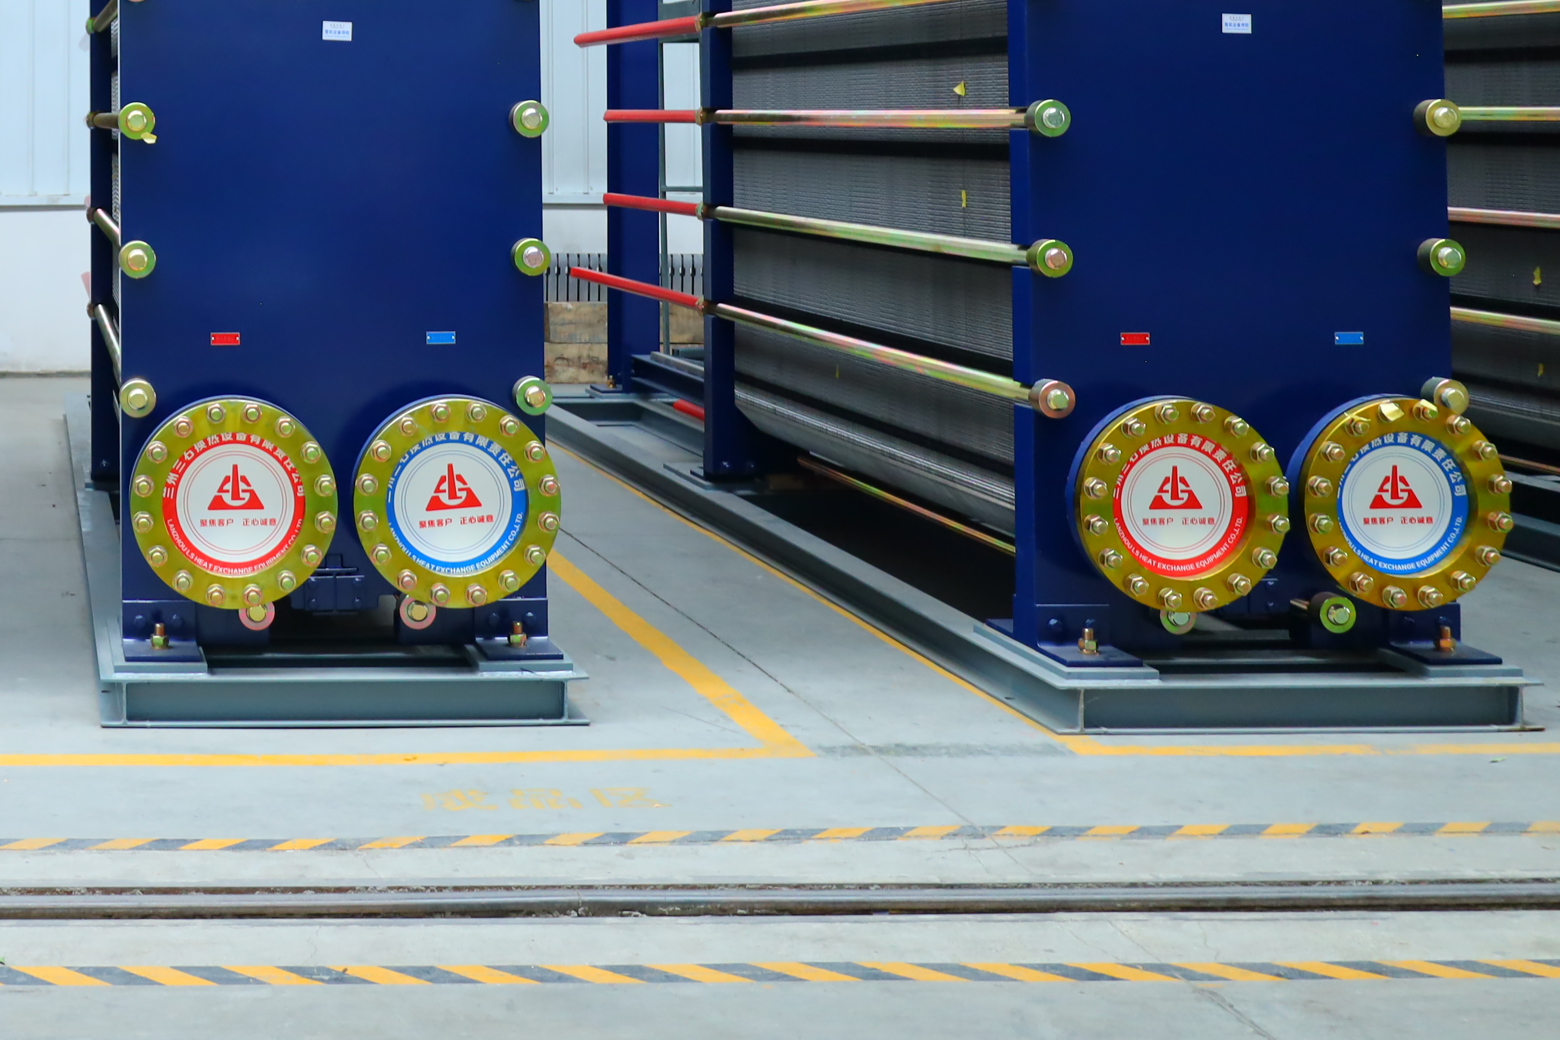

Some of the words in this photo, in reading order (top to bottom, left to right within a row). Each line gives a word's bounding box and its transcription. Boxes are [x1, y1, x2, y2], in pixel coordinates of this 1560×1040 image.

[200, 519, 233, 527] 聚焦客户
[243, 518, 277, 526] 正心诚意
[419, 520, 452, 528] 聚焦客户
[460, 515, 494, 525] 正心诚意
[1143, 518, 1173, 526] 聚焦客户
[1401, 517, 1434, 525] 正心诚意
[166, 518, 188, 552] LANZHOU
[193, 555, 213, 570] HEAT
[212, 564, 253, 574] EXCHANGE
[1113, 517, 1133, 549] LANZHOU
[1137, 552, 1157, 566] HEAT
[1156, 561, 1194, 571] EXCHANGE
[1194, 541, 1230, 569] EQUIPMENT
[415, 557, 435, 570] HEAT
[434, 563, 475, 573] EXCHANGE
[475, 539, 511, 569] EQUIPMENT
[1359, 551, 1378, 566] HEAT
[1377, 560, 1415, 570] EXCHANGE
[1415, 540, 1450, 568] EQUIPMENT
